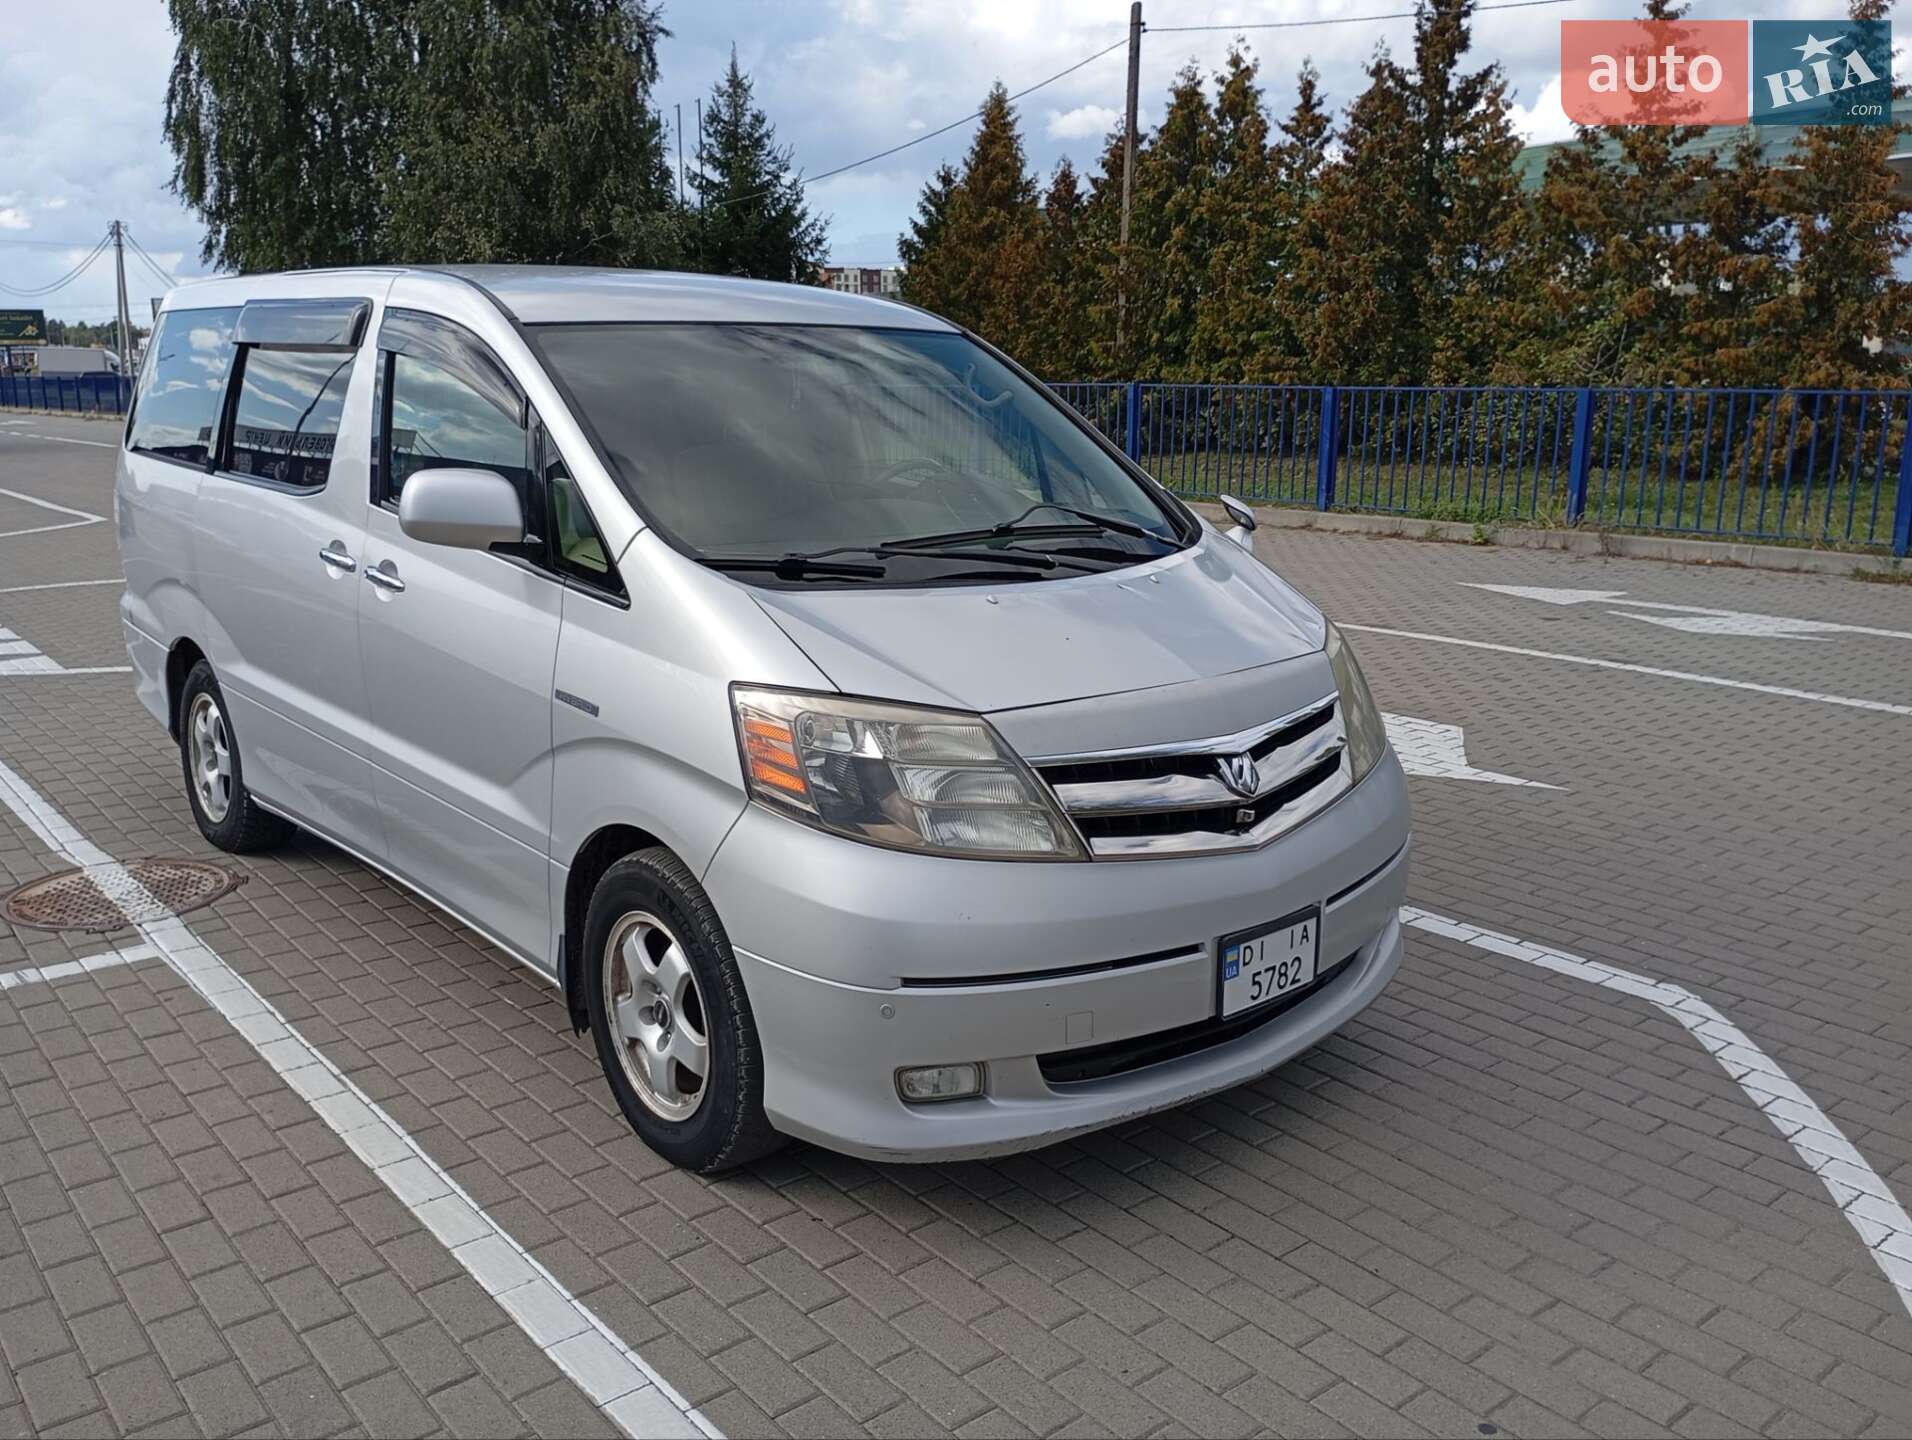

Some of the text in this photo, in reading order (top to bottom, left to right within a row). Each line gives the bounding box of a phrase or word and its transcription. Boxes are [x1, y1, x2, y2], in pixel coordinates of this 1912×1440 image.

[1243, 924, 1309, 967] DI IA
[1225, 966, 1237, 978] UA
[1250, 956, 1302, 1000] 5782
